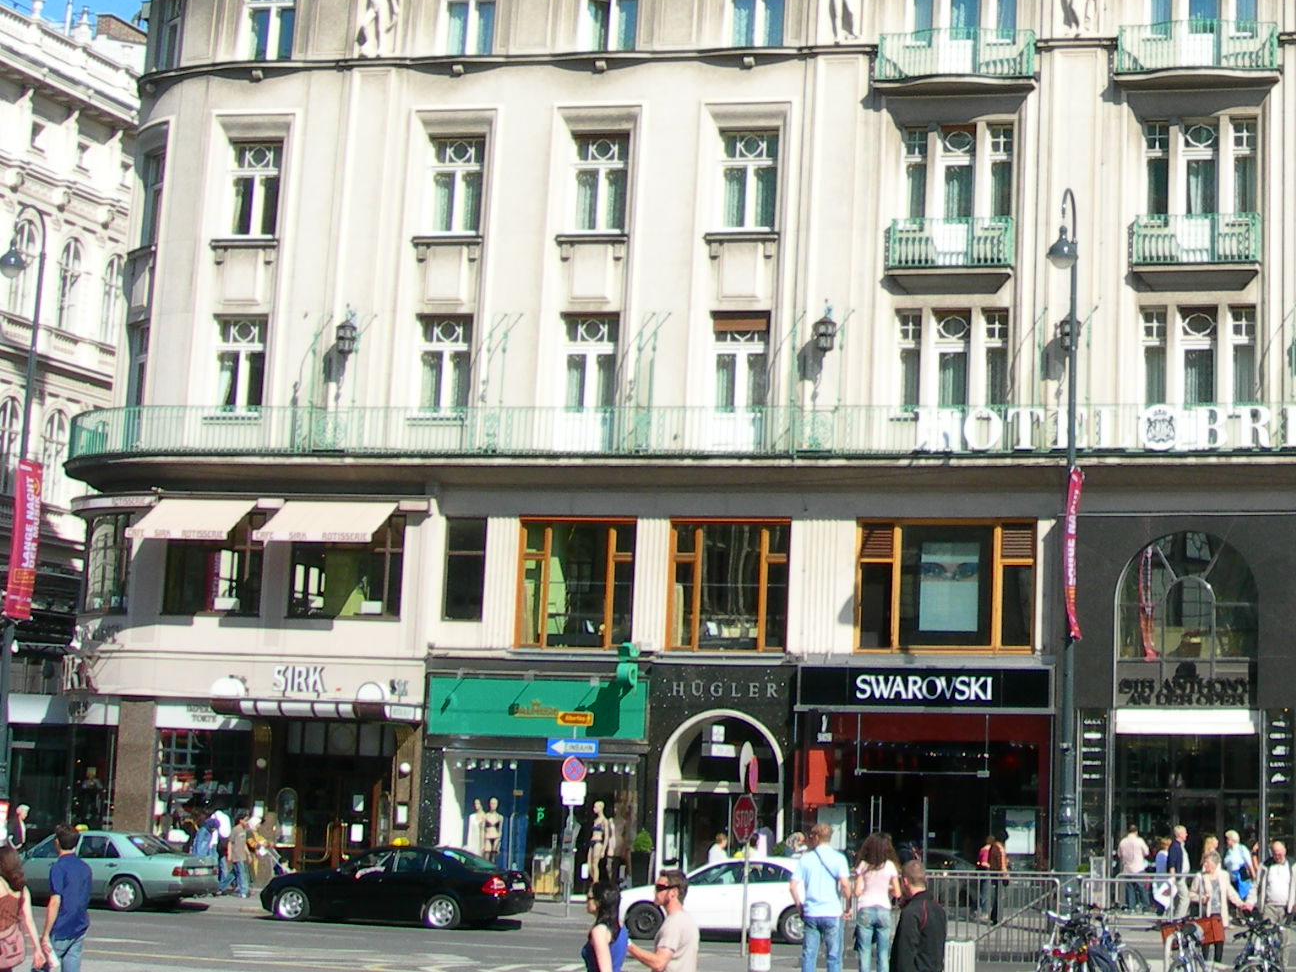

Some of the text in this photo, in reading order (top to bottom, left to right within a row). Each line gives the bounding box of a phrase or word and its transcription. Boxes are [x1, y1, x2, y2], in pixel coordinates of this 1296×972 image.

[913, 407, 1127, 451] HOTEL
[26, 476, 34, 521] NACHT
[21, 524, 34, 568] LANGE
[272, 665, 326, 695] SIRK
[855, 673, 994, 701] SWAROVSKI
[735, 810, 755, 828] STOP
